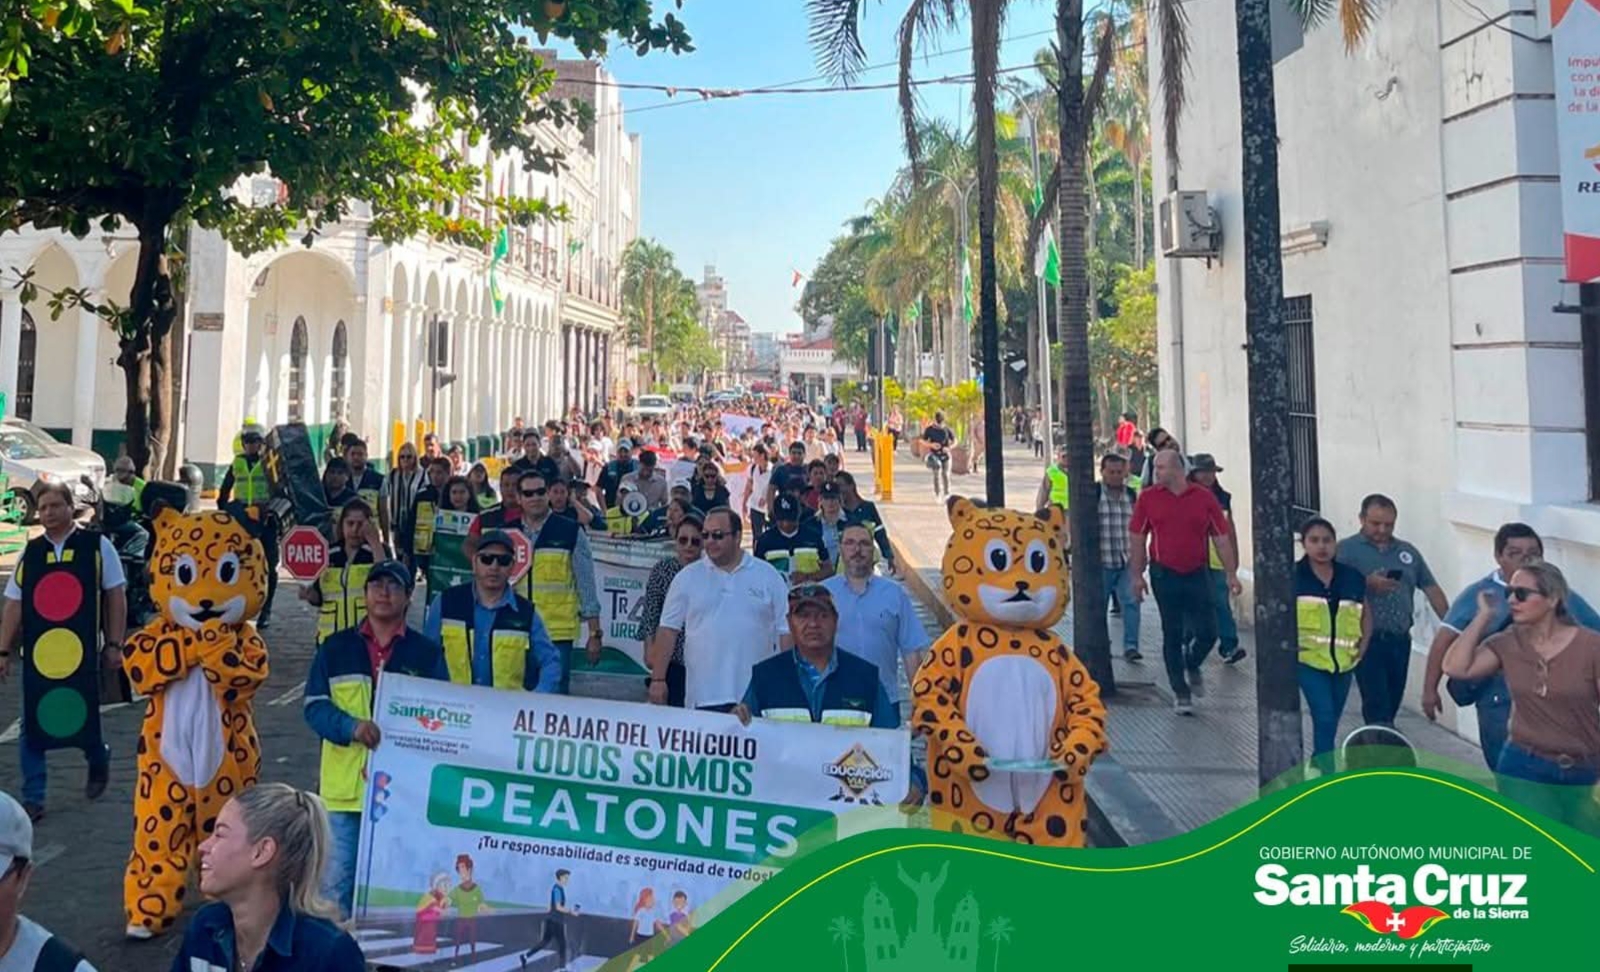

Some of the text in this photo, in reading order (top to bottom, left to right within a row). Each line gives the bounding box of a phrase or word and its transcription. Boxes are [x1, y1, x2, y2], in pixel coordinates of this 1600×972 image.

[287, 544, 323, 564] PARE
[388, 702, 435, 719] Santa
[437, 707, 473, 725] Cruz
[513, 709, 538, 734] AL
[544, 711, 609, 743] BAJAR
[616, 721, 649, 749] DEL
[513, 734, 754, 797] TODOS SOMOS
[458, 777, 799, 859] PEATONES
[477, 835, 499, 850] ¡Tu
[501, 841, 612, 864] responsabilidad
[616, 853, 631, 865] es
[633, 854, 704, 875] seguridad
[707, 863, 725, 877] de
